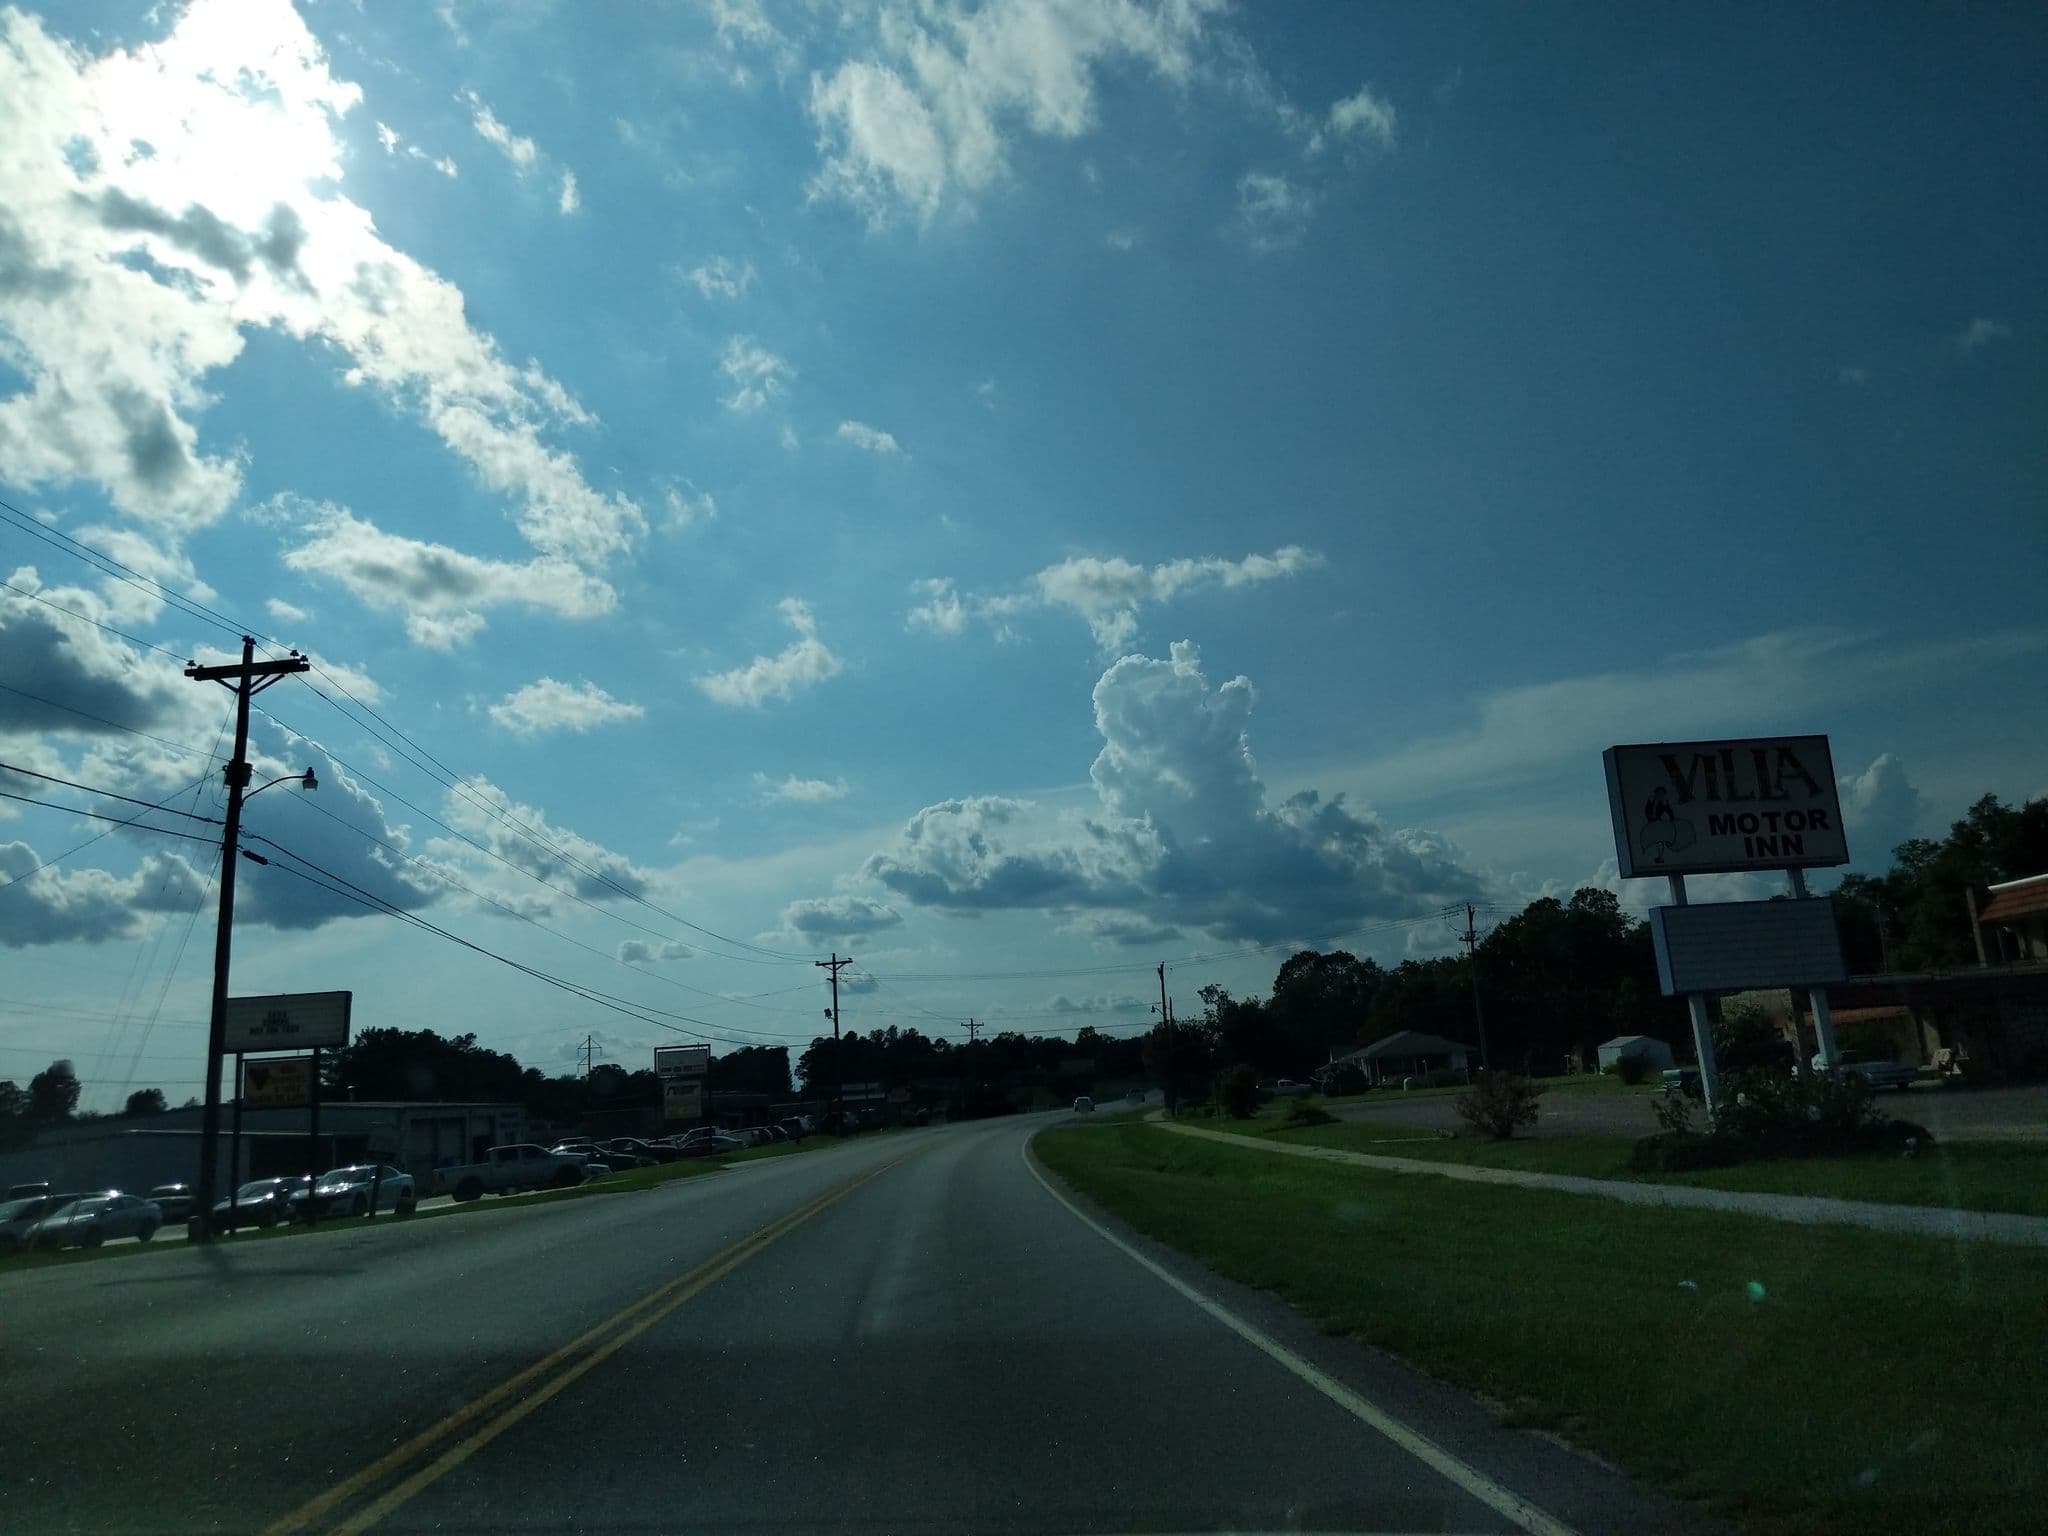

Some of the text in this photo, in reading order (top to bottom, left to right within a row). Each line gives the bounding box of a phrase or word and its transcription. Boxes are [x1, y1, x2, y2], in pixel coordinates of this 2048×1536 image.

[1657, 747, 1824, 804] VILLA
[1709, 809, 1830, 835] MOTOR
[1744, 834, 1804, 858] INN
